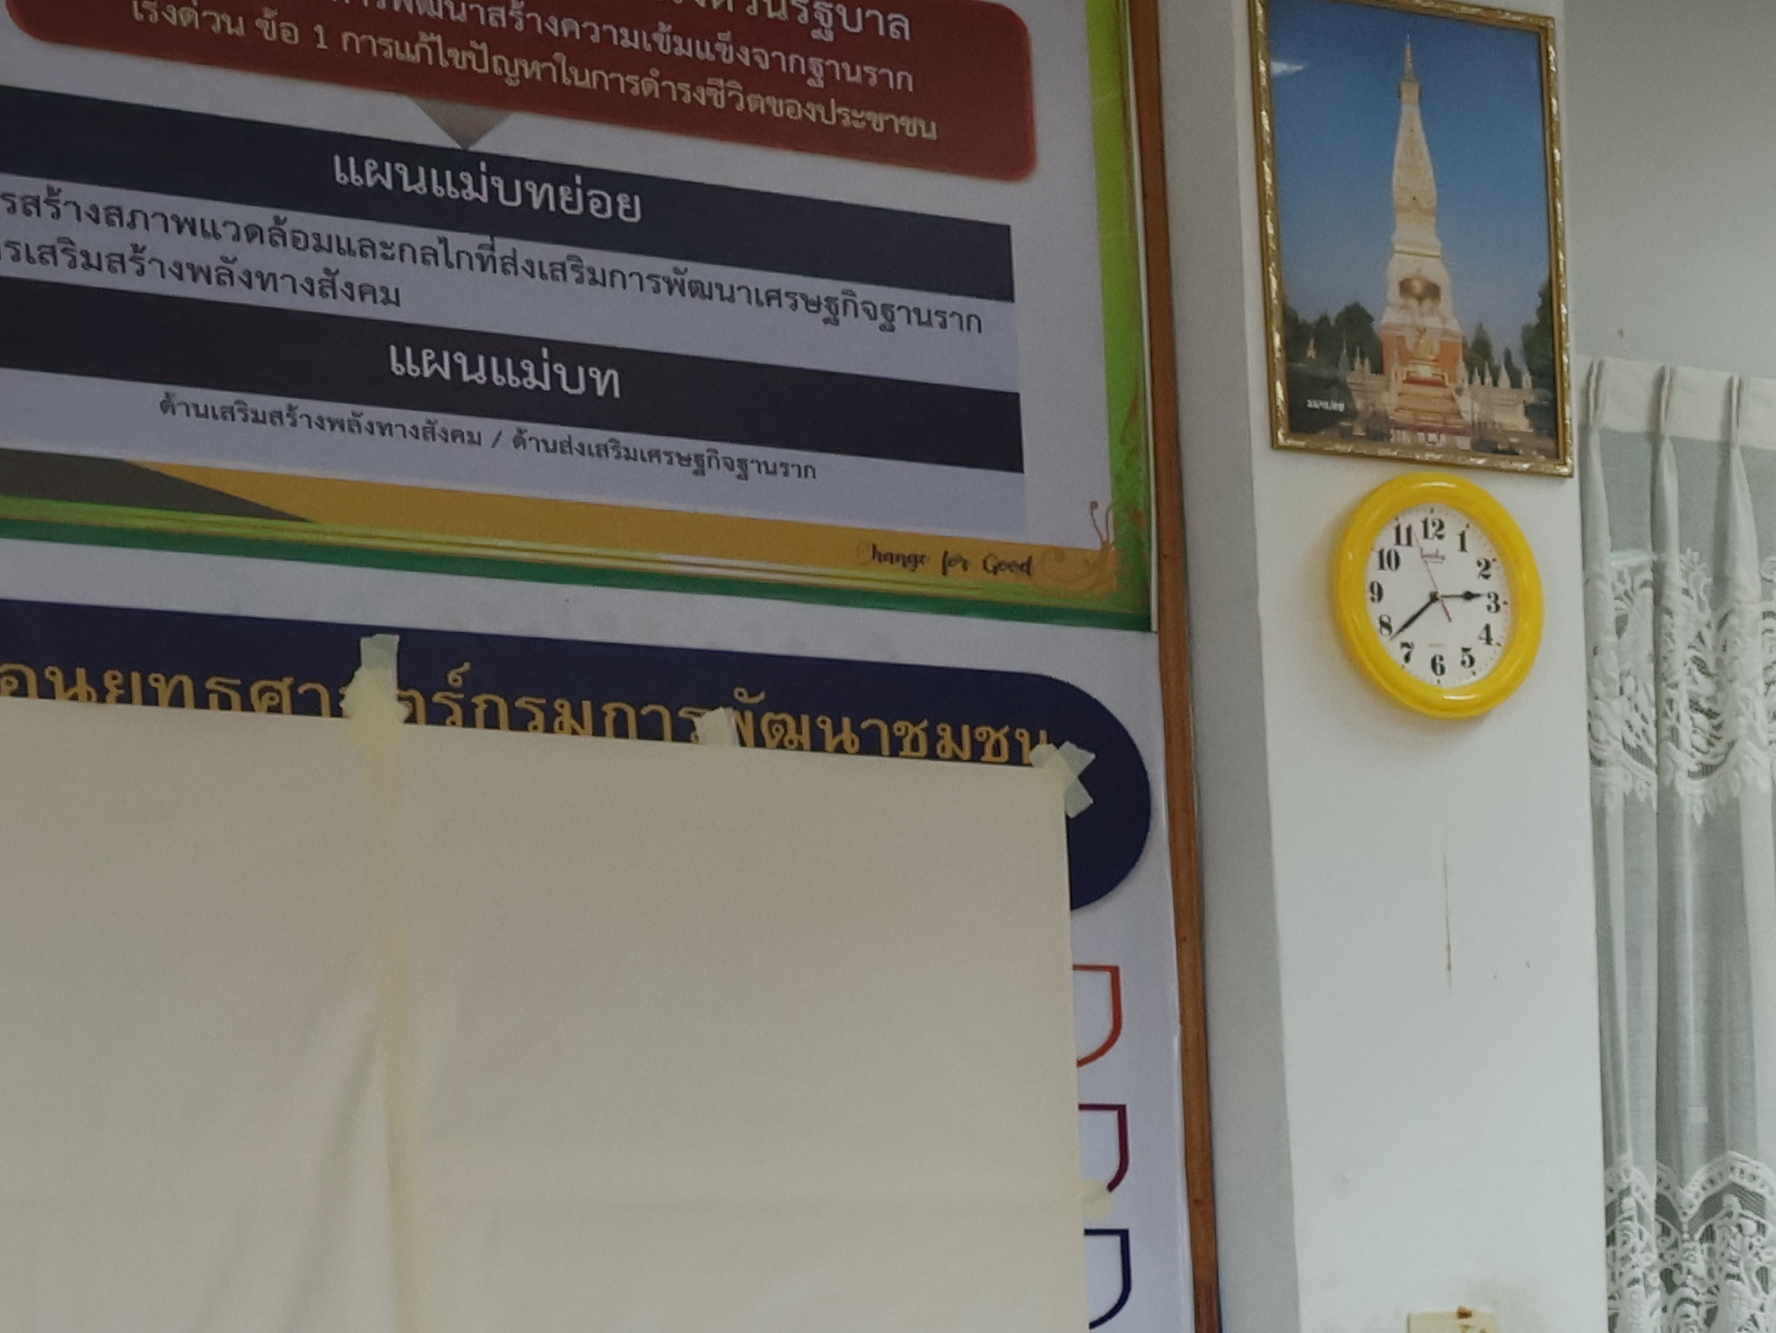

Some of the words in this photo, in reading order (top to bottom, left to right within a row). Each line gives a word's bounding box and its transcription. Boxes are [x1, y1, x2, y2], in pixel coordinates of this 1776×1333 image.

[314, 25, 328, 50] 1
[333, 153, 643, 224] แผนแม่บทย่อย
[0, 235, 402, 308] รเสริมสร้างพลังทางสังคม
[388, 338, 622, 401] แผนแม่บท
[1394, 523, 1413, 547] 11
[1421, 517, 1445, 540] 12
[1458, 530, 1468, 552] 1
[1378, 548, 1401, 571] 10
[1476, 558, 1492, 580] 2
[1369, 581, 1384, 603] 9
[1486, 591, 1501, 613] 3
[1378, 614, 1393, 636] 8
[1478, 623, 1493, 646] 4
[1400, 641, 1414, 664] 7
[1460, 647, 1475, 669] 5
[1430, 654, 1446, 676] 6
